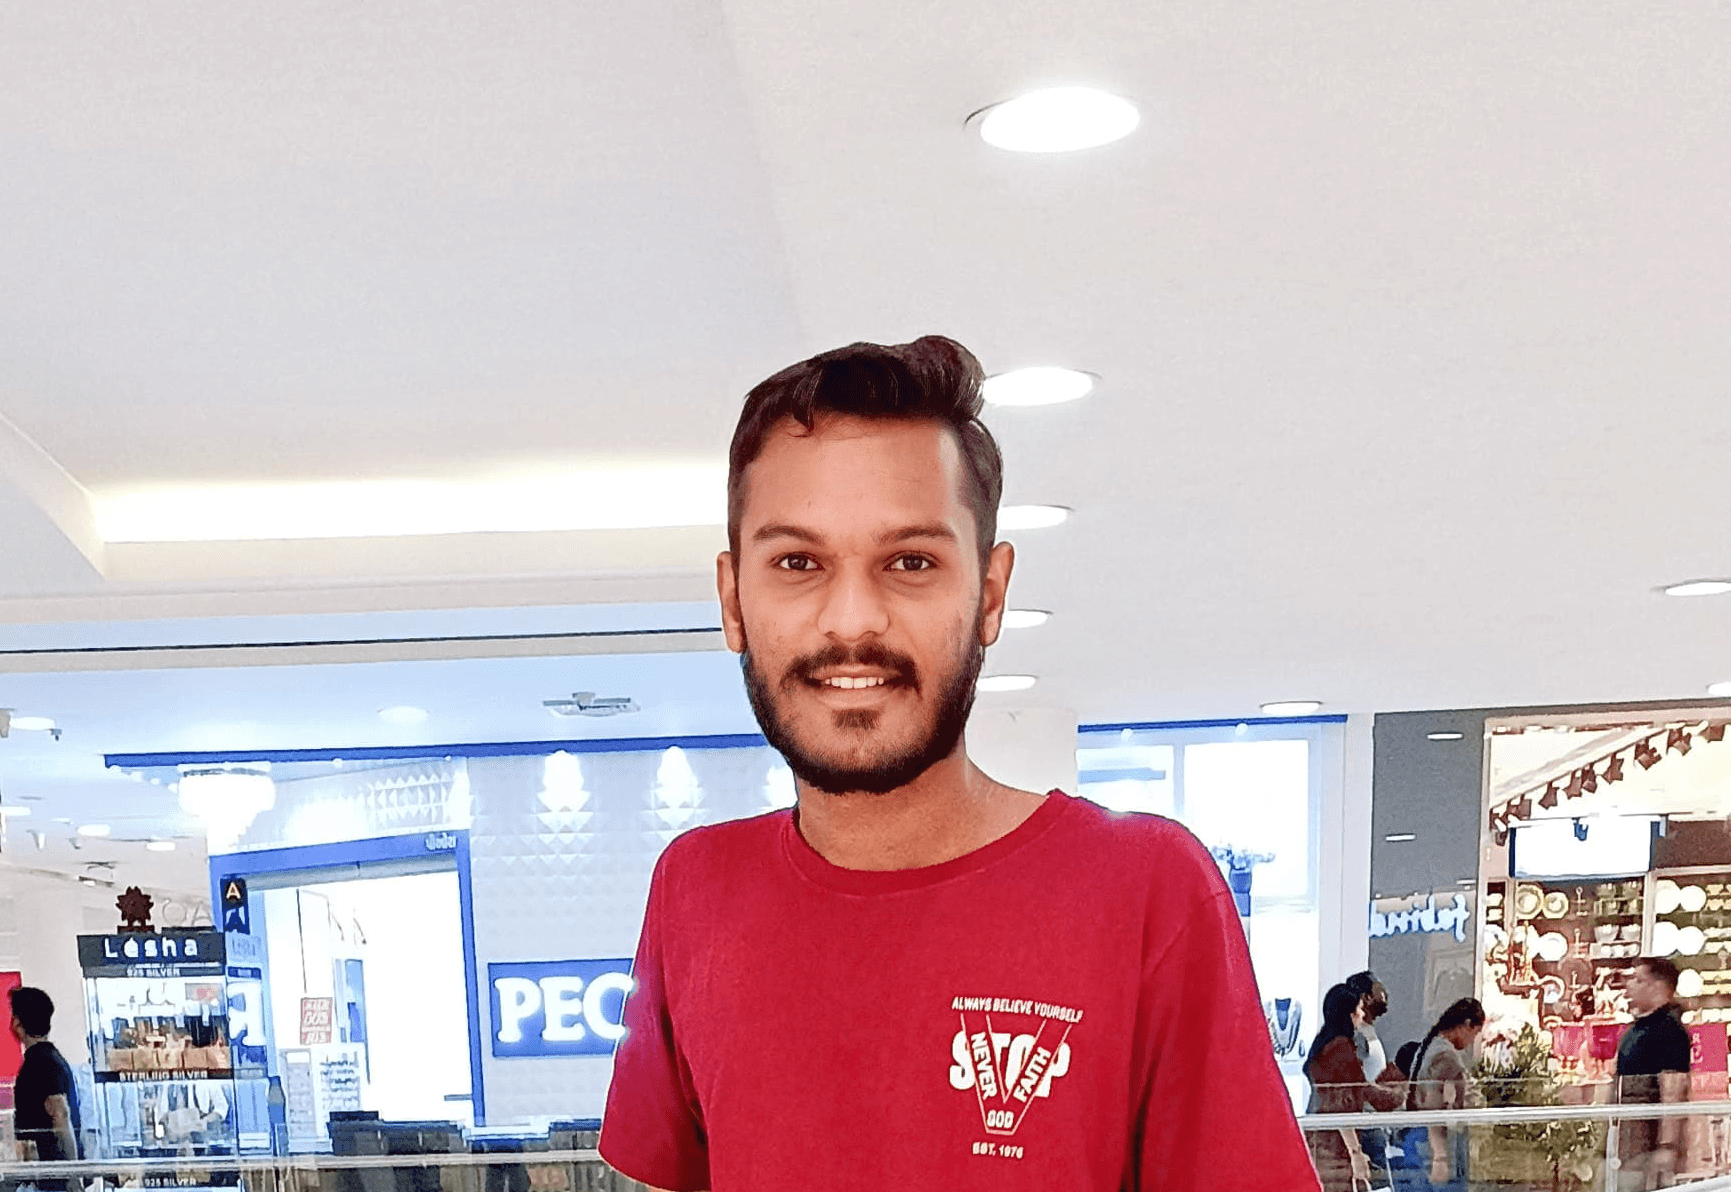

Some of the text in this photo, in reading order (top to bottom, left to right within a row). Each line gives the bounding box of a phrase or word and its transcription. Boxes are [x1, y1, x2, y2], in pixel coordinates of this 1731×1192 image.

[951, 996, 1083, 1023] ALWAYS BELIEVE YOURSELF
[971, 1031, 998, 1100] NEVER
[1012, 1047, 1051, 1102] FAITH
[986, 1109, 1015, 1129] GOD
